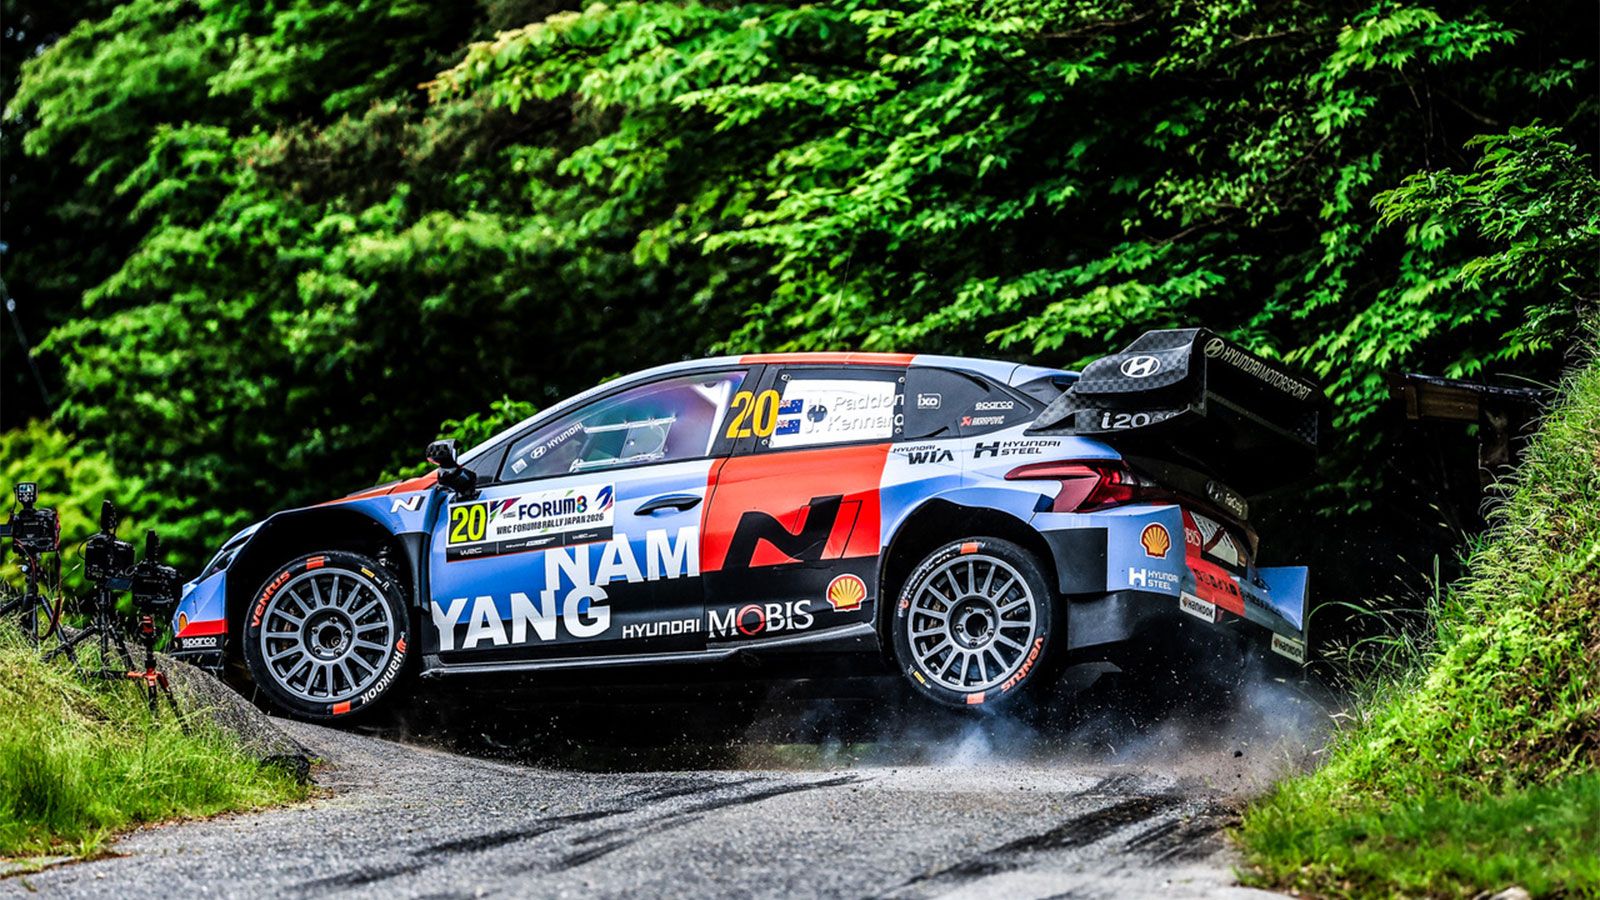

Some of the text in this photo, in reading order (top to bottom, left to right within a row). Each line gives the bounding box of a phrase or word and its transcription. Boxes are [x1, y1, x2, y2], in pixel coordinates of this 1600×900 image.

[1221, 346, 1312, 400] HYUNDAI MOTORSPORT
[725, 389, 780, 439] 20
[833, 393, 904, 412] Paddon
[546, 422, 584, 450] HYUNDAI
[1002, 440, 1062, 448] HYUNDAI
[893, 444, 936, 454] HYUNDAI
[1000, 447, 1043, 456] STEEL
[518, 495, 588, 521] FORUM8
[450, 503, 487, 543] 20
[496, 512, 604, 535] WRC FORUM8 RALLY JAPAN 2026
[545, 525, 701, 591] NAM
[1147, 570, 1179, 583] HYUNDAI
[1147, 579, 1172, 591] STEEL
[431, 585, 611, 651] YANG
[622, 600, 815, 639] HYUNDAI MOBIS
[182, 637, 217, 649] sparco
